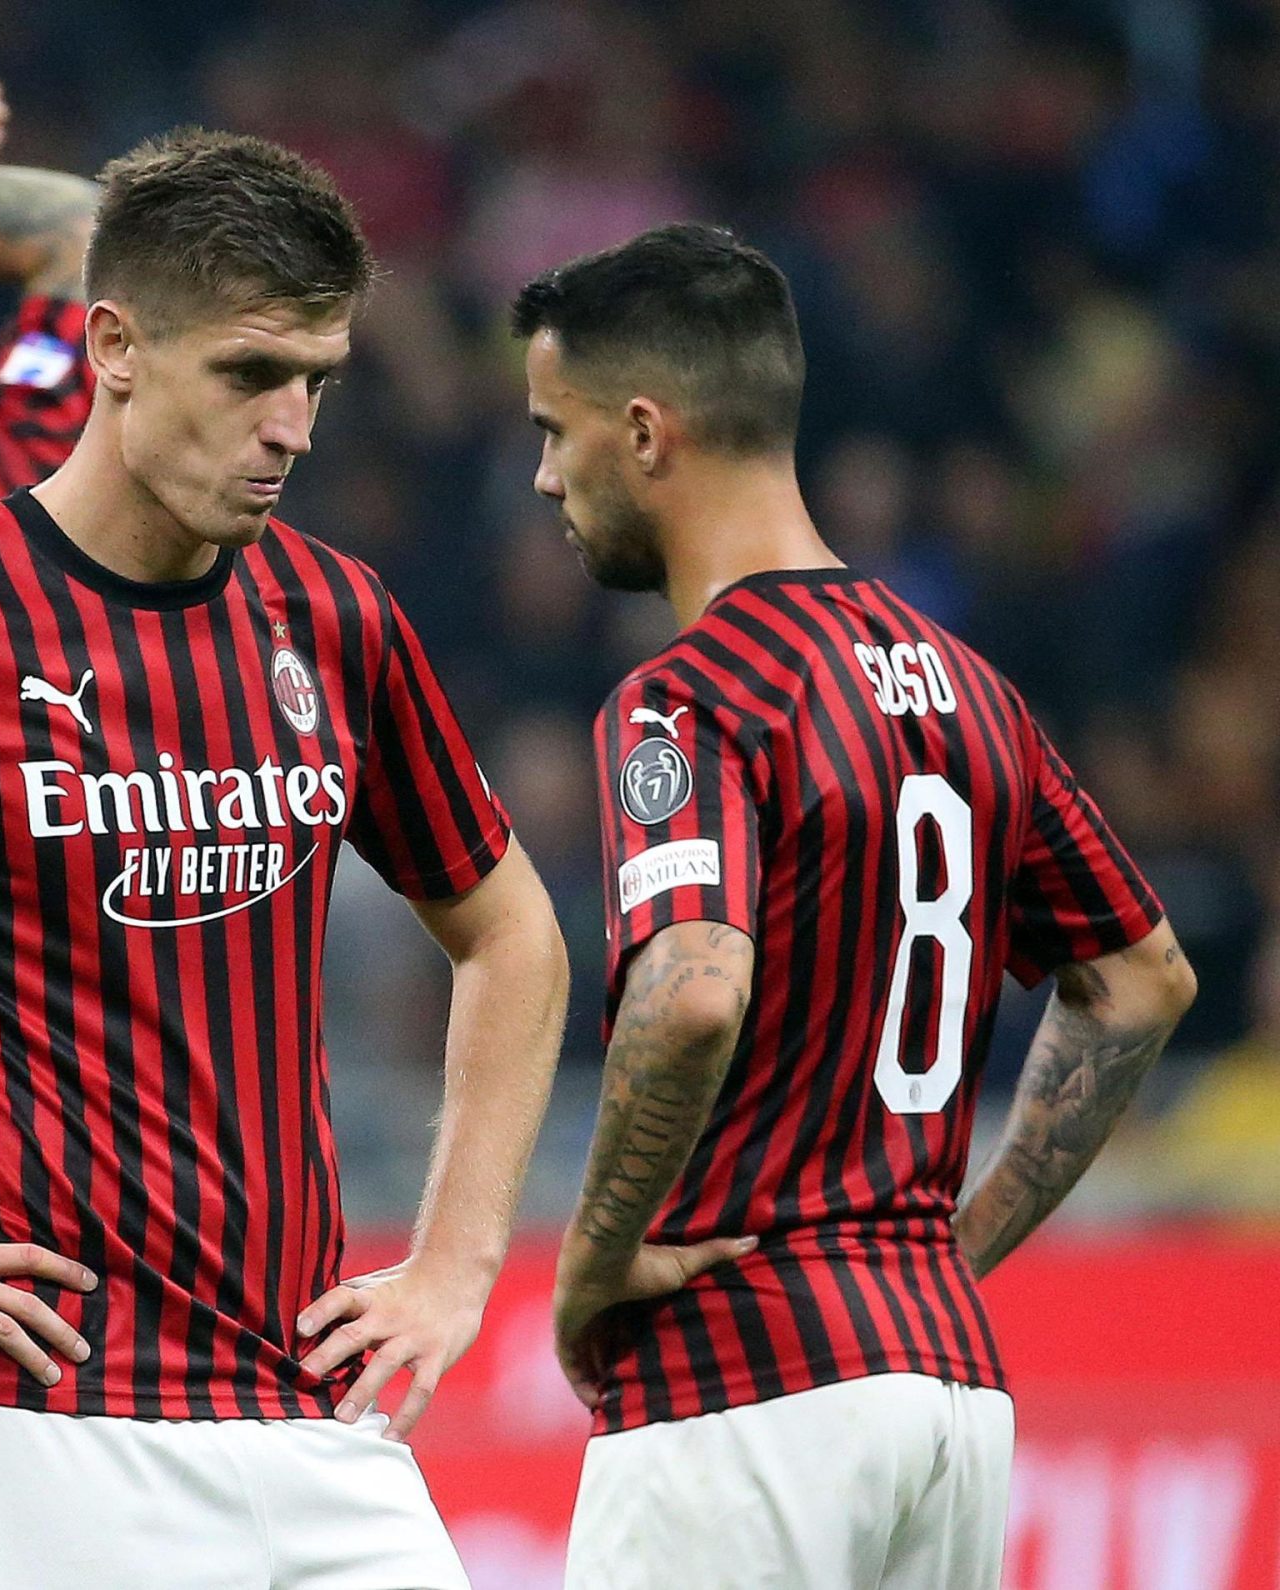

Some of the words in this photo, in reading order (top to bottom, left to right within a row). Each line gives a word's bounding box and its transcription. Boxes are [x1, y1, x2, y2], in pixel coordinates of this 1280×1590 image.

[853, 641, 957, 717] SUSO
[18, 752, 346, 838] Emirates
[122, 846, 172, 897] FLY
[180, 843, 285, 896] BETTER
[646, 860, 717, 889] MILAN
[873, 774, 973, 1115] 8
